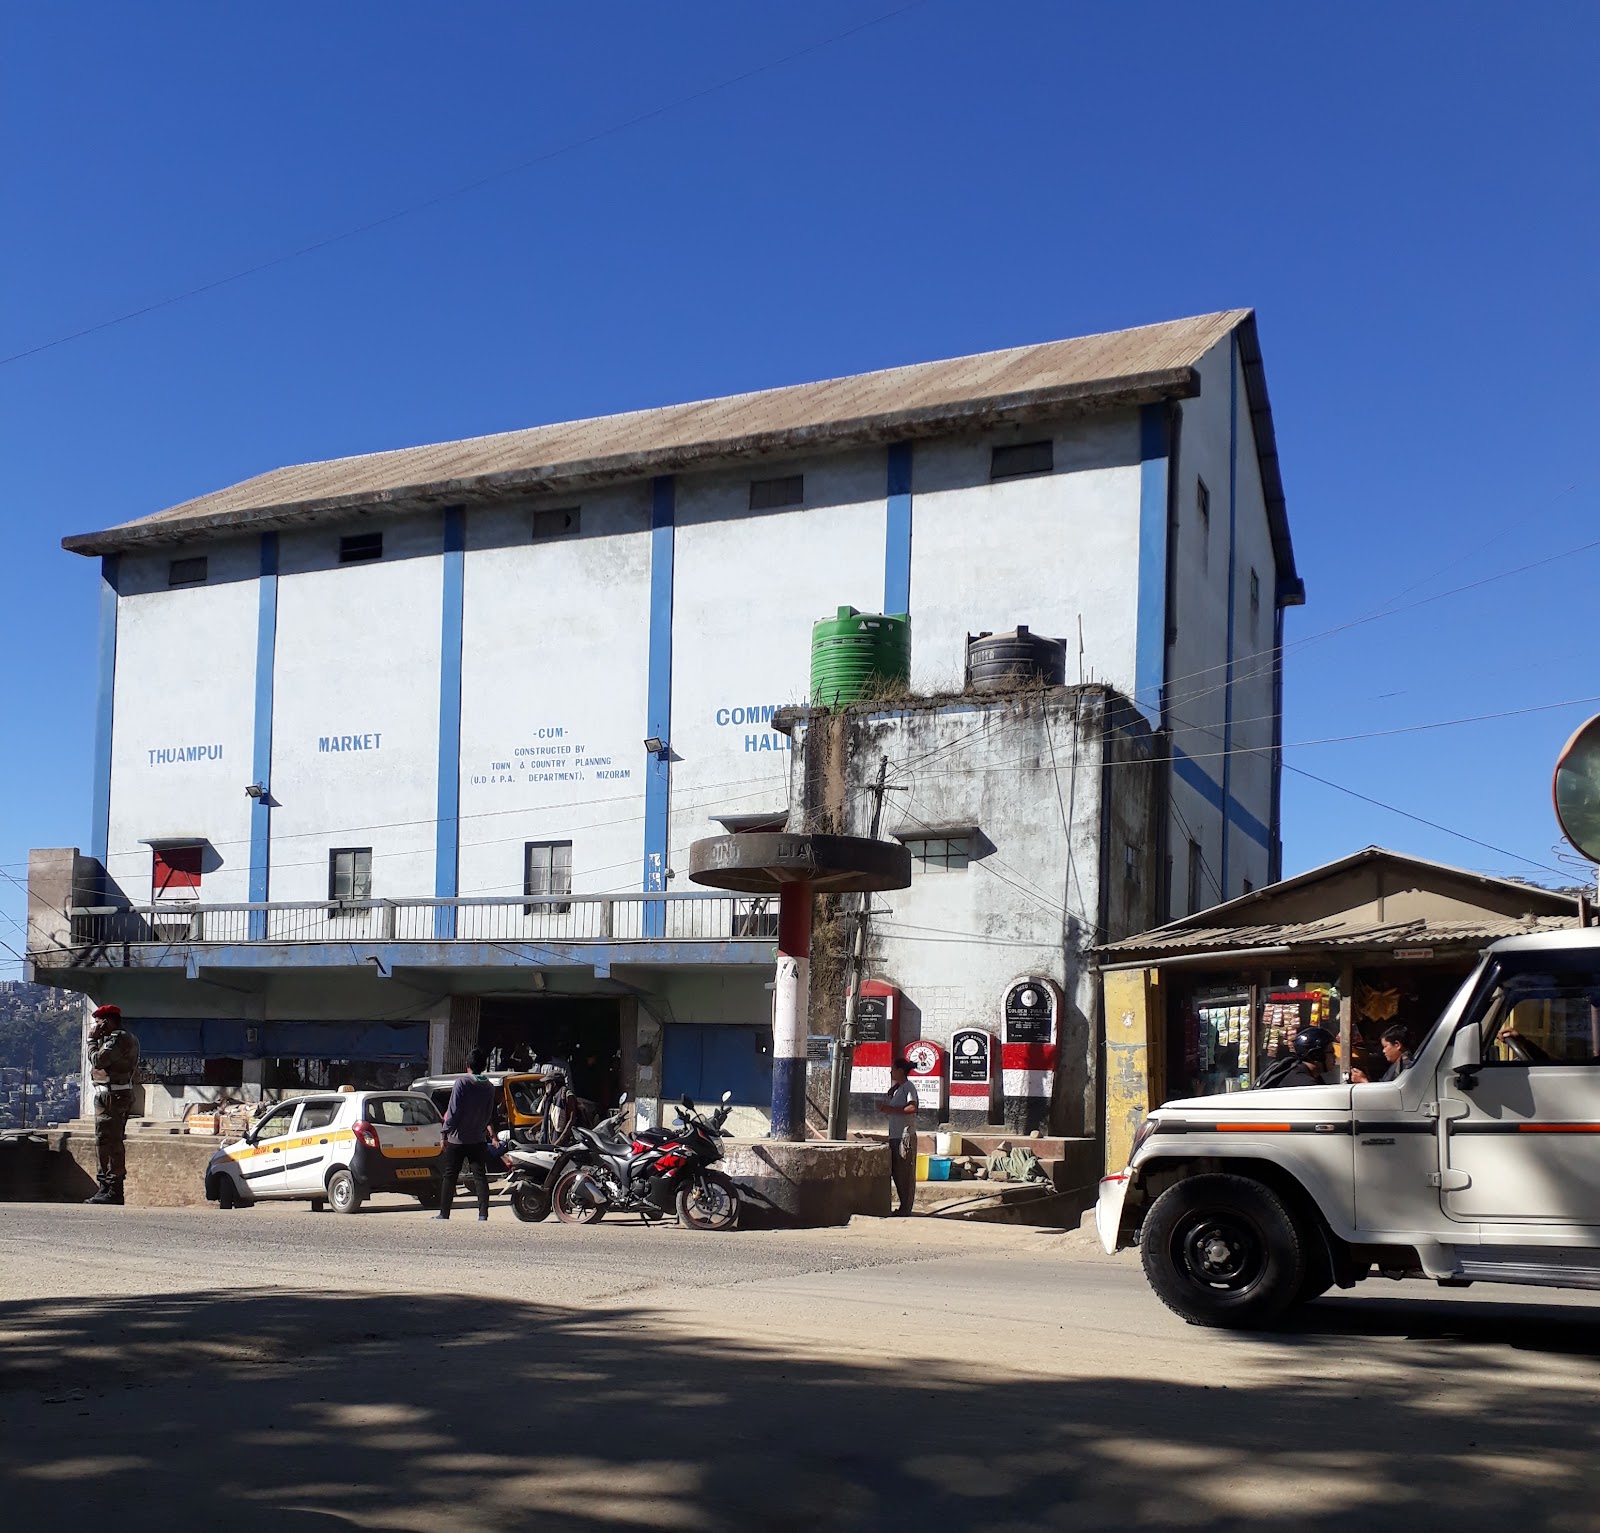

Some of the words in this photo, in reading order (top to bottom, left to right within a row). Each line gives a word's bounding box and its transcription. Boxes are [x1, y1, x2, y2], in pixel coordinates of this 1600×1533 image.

[716, 703, 809, 726] COMM
[533, 727, 569, 739] -CUM-
[318, 733, 382, 752] MARKET
[514, 745, 571, 756] CONSTRUCTED
[575, 745, 585, 753] BY
[492, 762, 511, 770] TOWN
[520, 761, 525, 769] &
[531, 759, 566, 769] COUNTRY
[575, 757, 612, 767] PLANNING
[491, 775, 496, 783] &
[500, 775, 516, 783] P.A.
[528, 771, 585, 782] DEPARTMENT),
[596, 769, 631, 779] MIZORAM
